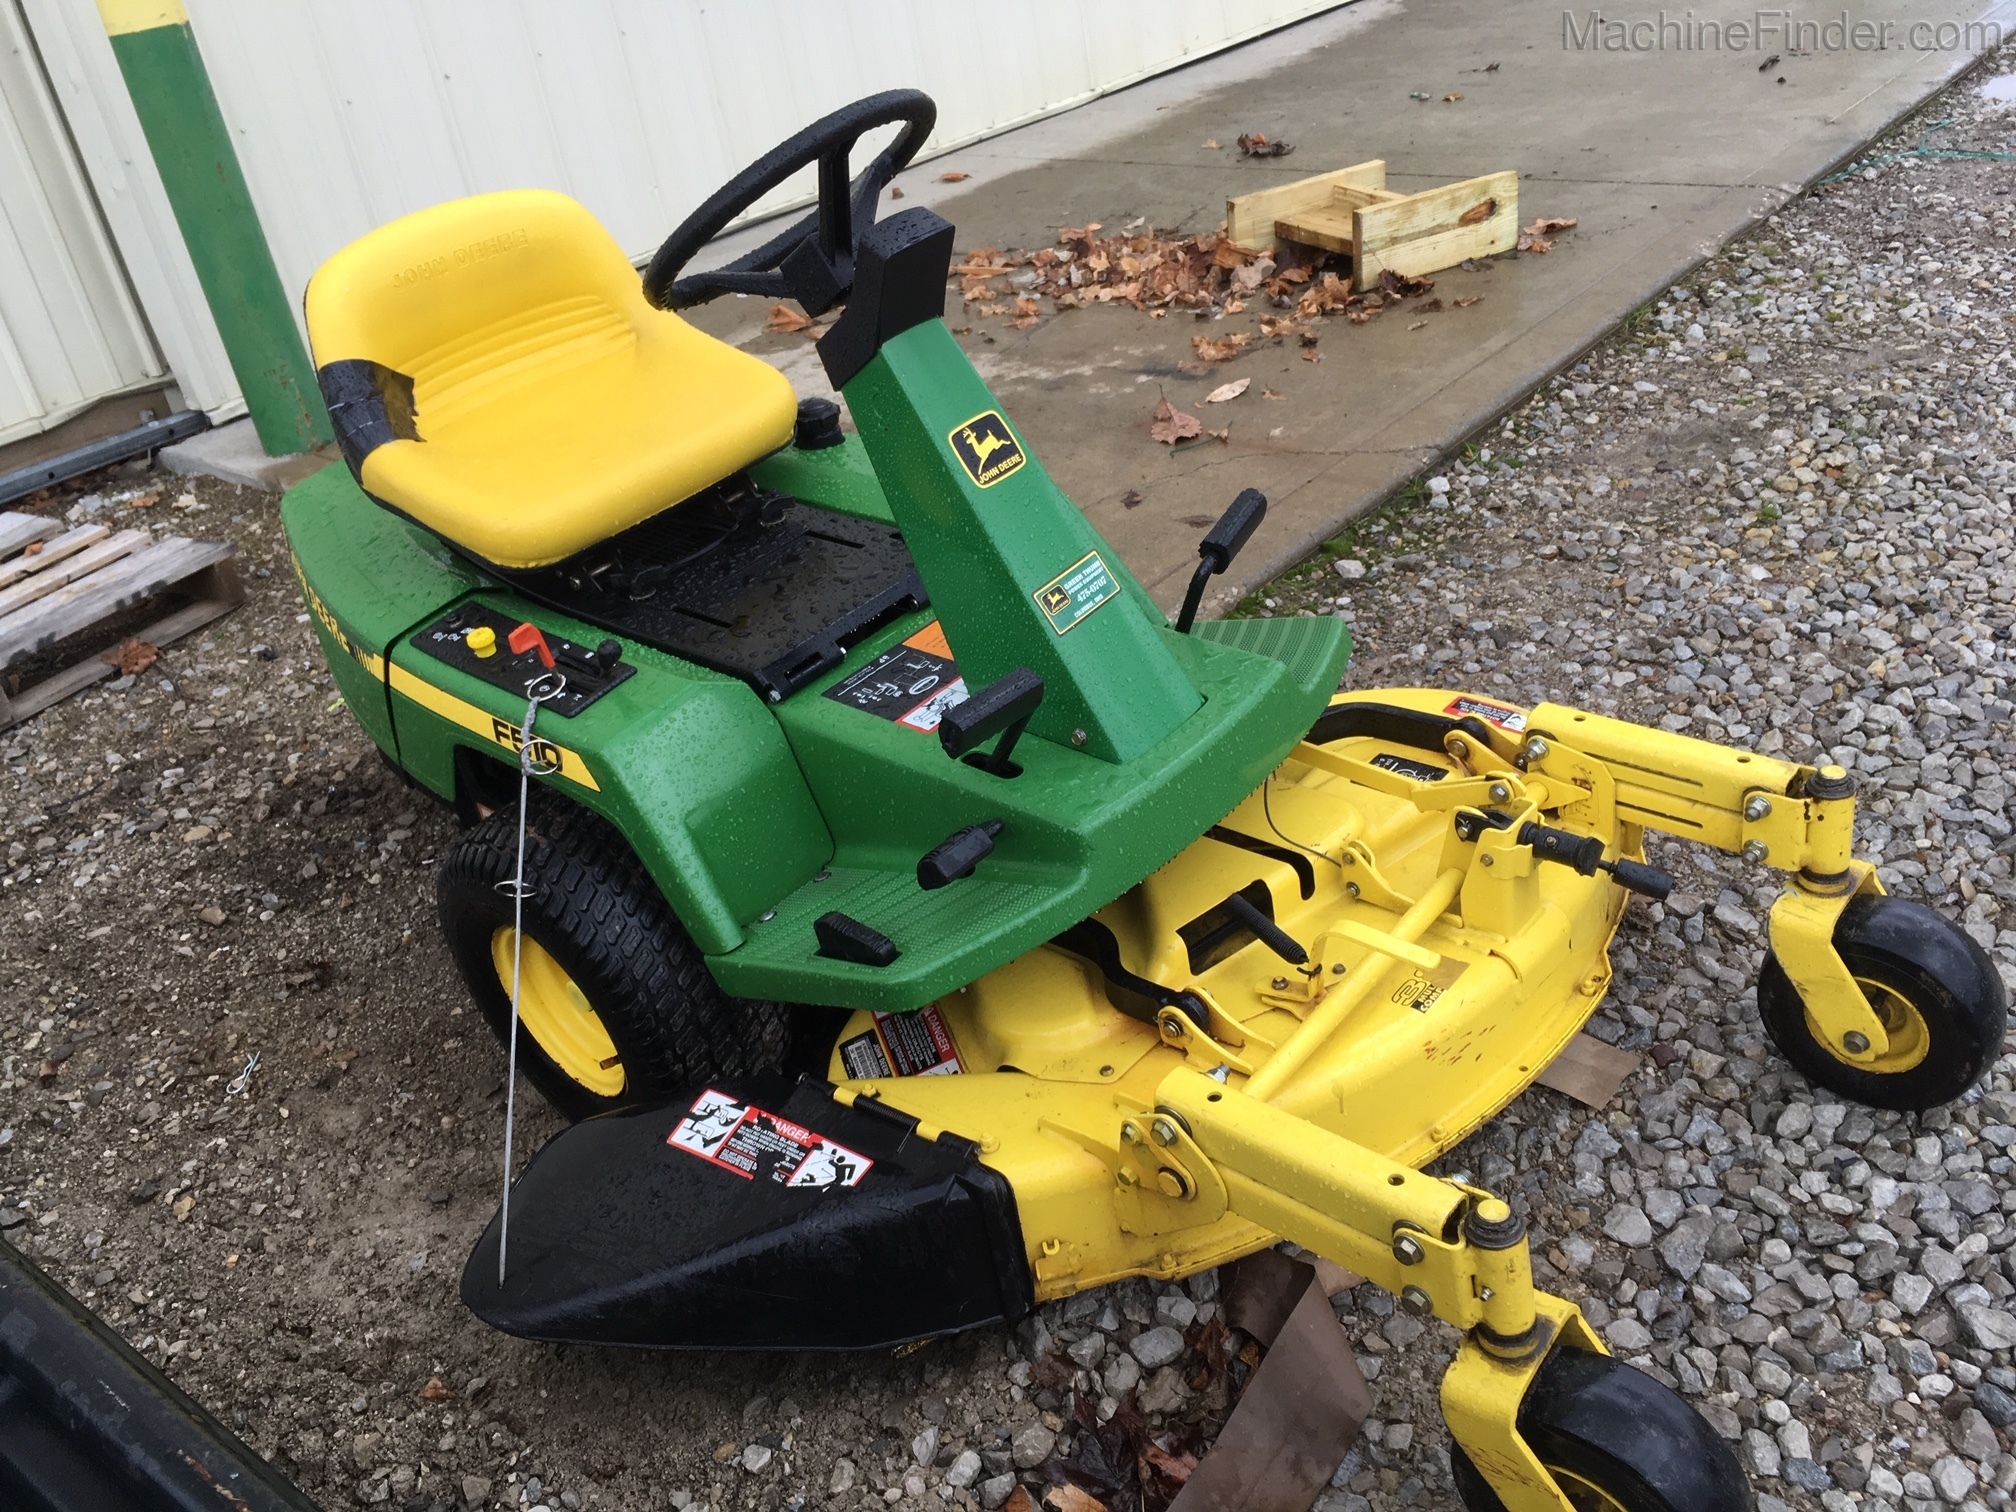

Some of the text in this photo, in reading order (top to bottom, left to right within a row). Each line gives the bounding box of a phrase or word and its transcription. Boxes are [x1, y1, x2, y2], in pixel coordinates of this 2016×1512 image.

[393, 228, 529, 290] JOHN DEERE
[979, 453, 1022, 484] JOHN DEERE
[1063, 560, 1101, 590] GREEN THUMB
[1077, 575, 1107, 602] 475-0707
[928, 1015, 950, 1053] DANGER
[871, 1042, 891, 1076] JOHN DEERE
[741, 1136, 765, 1149] THROWN
